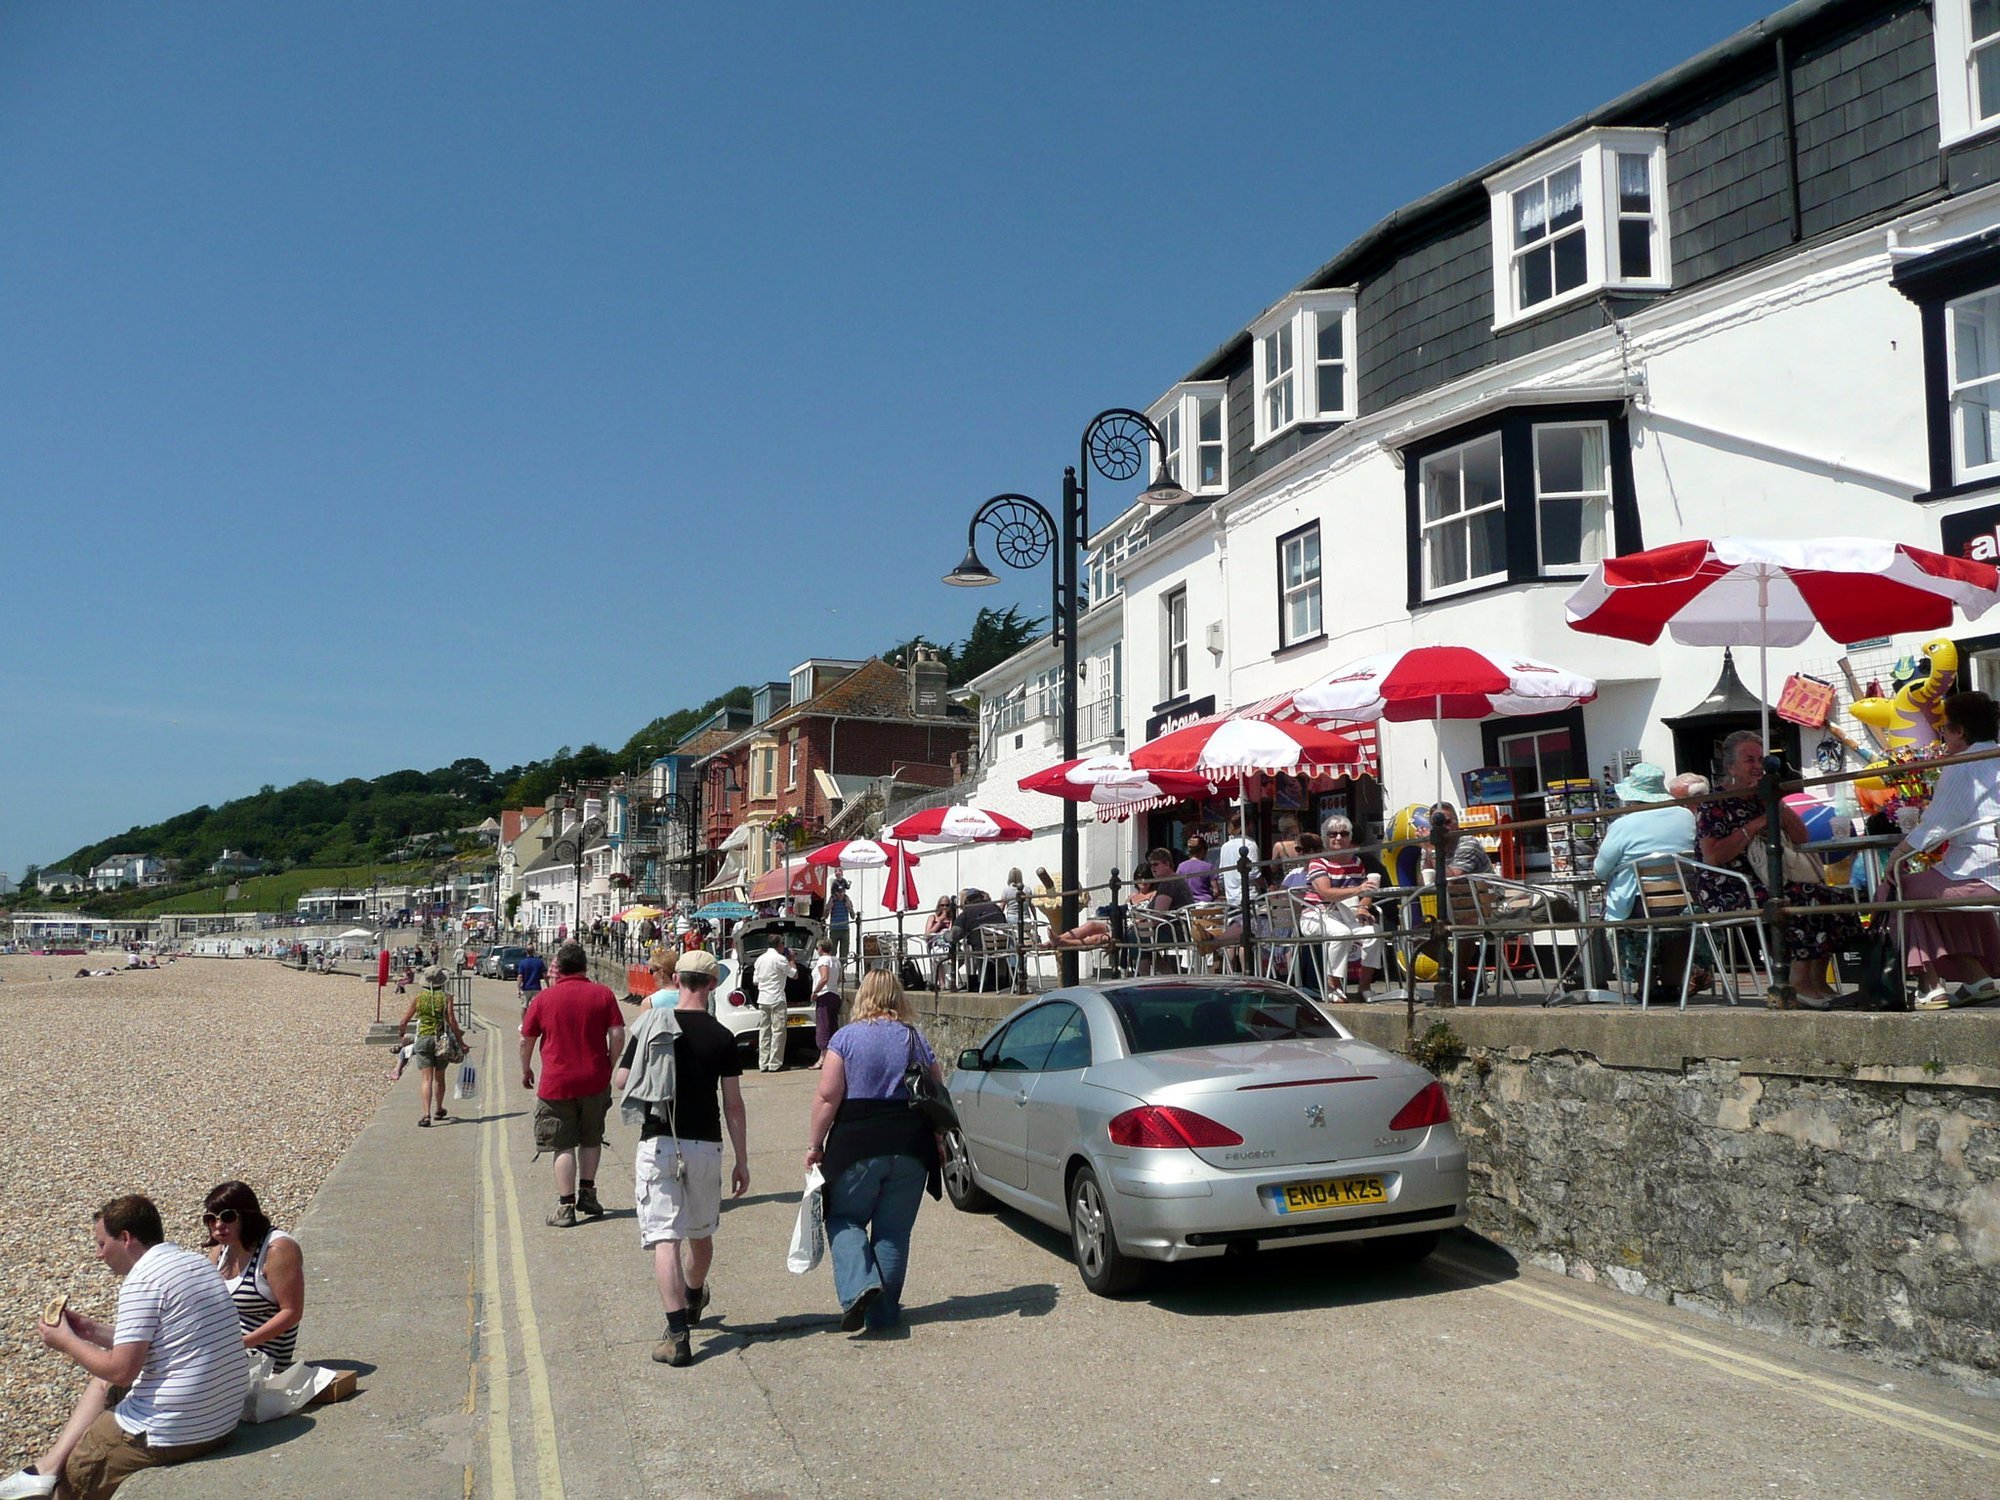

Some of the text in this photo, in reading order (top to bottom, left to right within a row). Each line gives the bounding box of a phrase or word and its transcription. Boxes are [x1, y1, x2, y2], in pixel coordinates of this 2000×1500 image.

[1224, 1150, 1276, 1161] PEUGEOT
[1286, 1178, 1383, 1207] EN04 KZS
